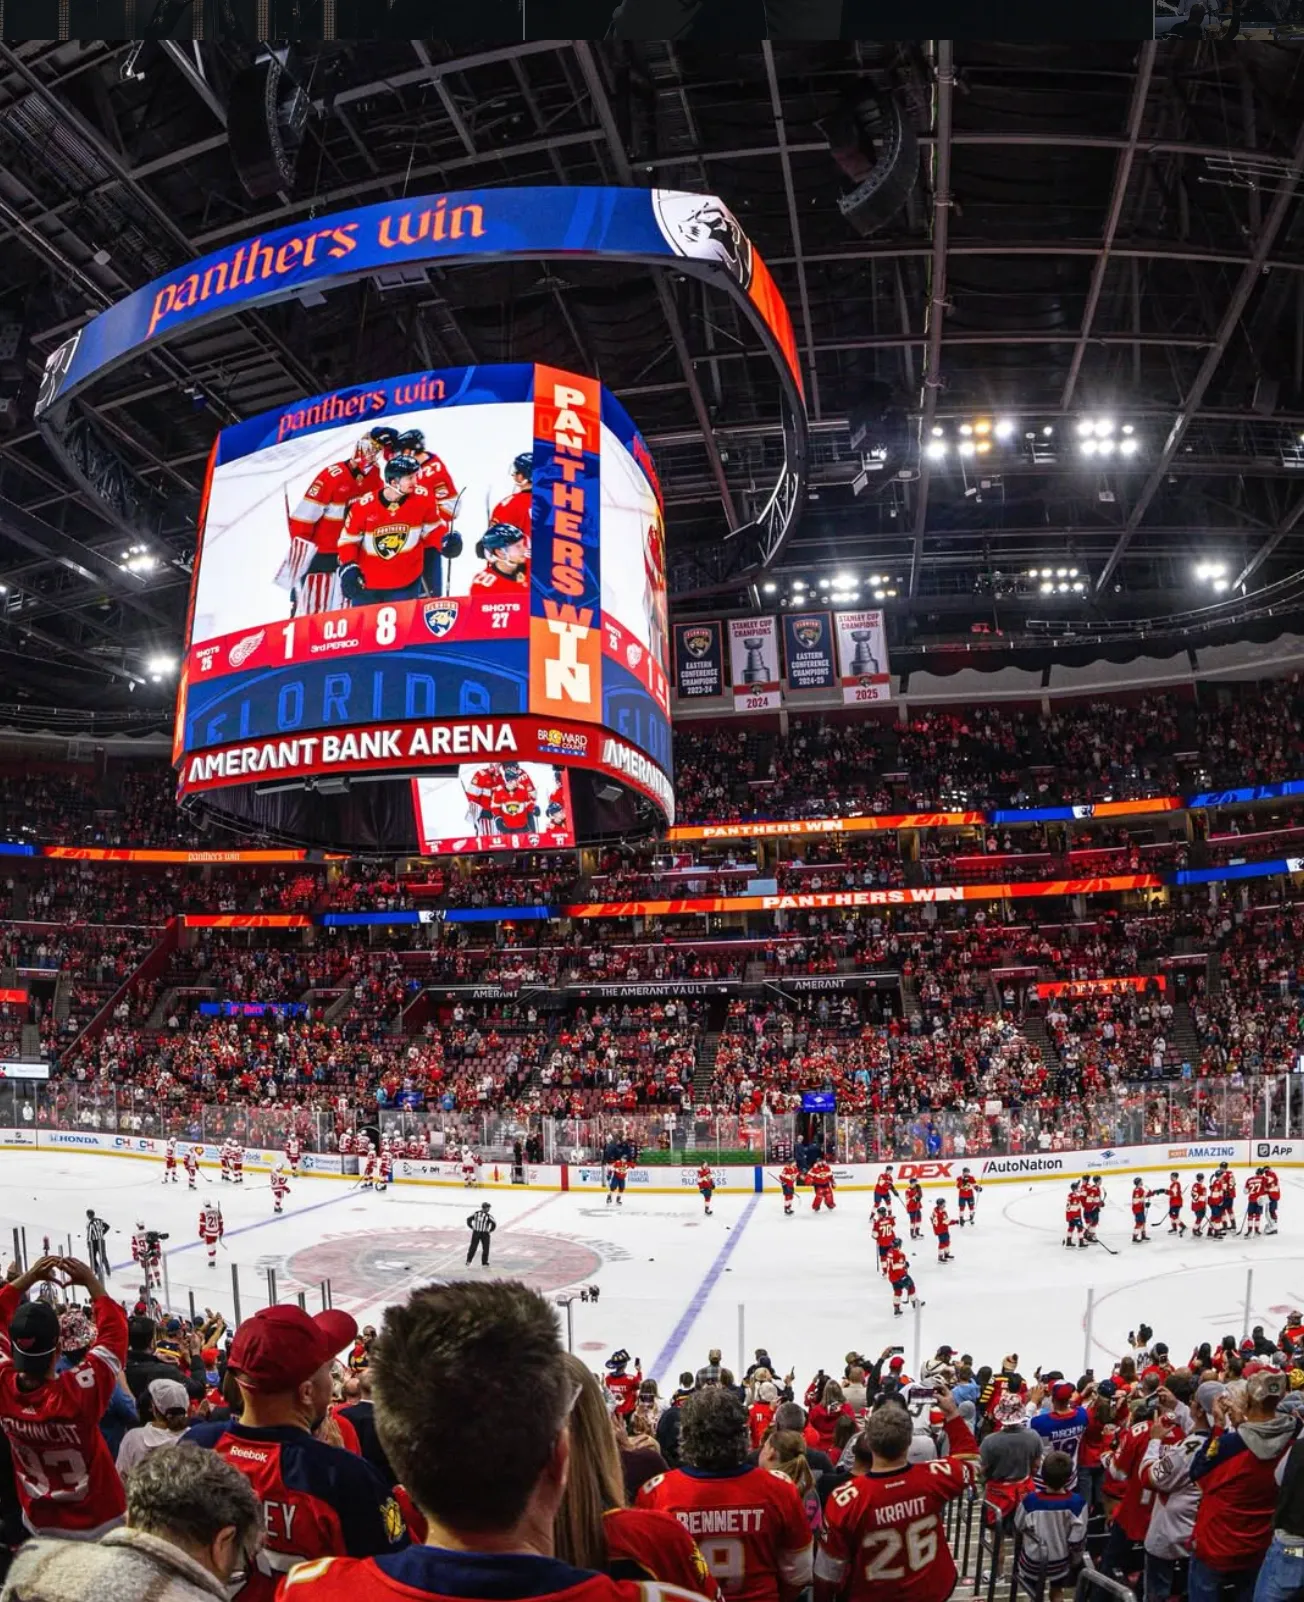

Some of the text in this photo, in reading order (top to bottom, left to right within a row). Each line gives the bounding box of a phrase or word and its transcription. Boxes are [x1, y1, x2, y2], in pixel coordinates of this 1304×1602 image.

[146, 196, 486, 339] panthers win
[277, 376, 446, 443] panthers win
[552, 384, 586, 597] PANTHERS
[481, 603, 520, 613] SHOTS
[323, 619, 348, 640] 0.0
[375, 606, 397, 645] 8
[491, 613, 509, 628] 27
[282, 622, 295, 660] 1
[543, 598, 593, 704] WIN
[196, 646, 220, 658] SHOTS
[747, 697, 769, 709] 2024
[855, 688, 878, 700] 2025
[188, 723, 517, 782] AMERANT BANK ARENA
[703, 820, 842, 836] PANTHERS WIN
[762, 888, 964, 909] PANTHERS WIN
[601, 985, 707, 996] THE AMERANT VAULT
[795, 979, 846, 989] AMERANT
[59, 1135, 99, 1144] HONDA
[1188, 1147, 1235, 1157] AMAZING
[898, 1163, 954, 1179] DEX
[987, 1158, 1063, 1173] AutoNation
[229, 1445, 268, 1463] Reebok
[263, 1500, 296, 1539] EY
[676, 1508, 764, 1534] BENNETT
[875, 1496, 927, 1525] KRAVIT
[862, 1513, 938, 1581] 26
[700, 1537, 745, 1592] 9
